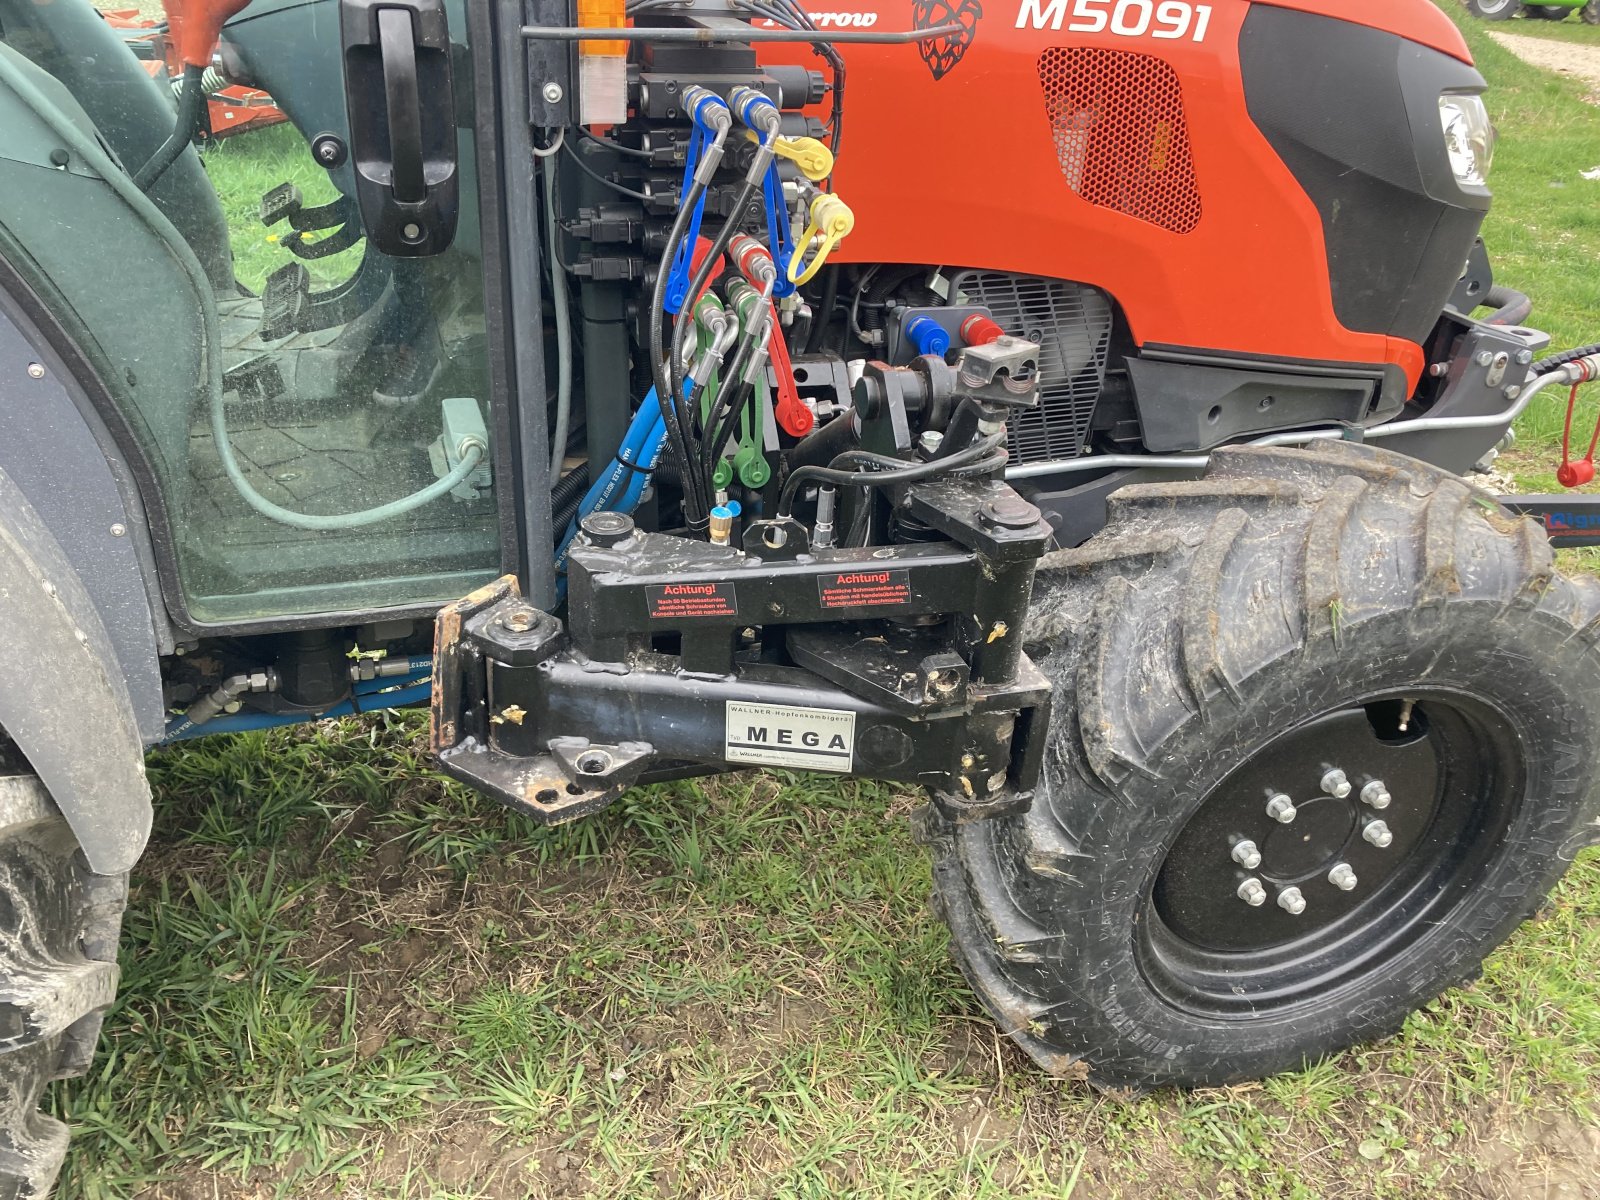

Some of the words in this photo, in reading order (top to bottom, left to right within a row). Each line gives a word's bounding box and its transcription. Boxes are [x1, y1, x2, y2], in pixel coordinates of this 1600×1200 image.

[1014, 0, 1213, 43] M5091
[836, 572, 890, 585] Achtung!
[664, 583, 716, 595] Achtung!
[861, 591, 909, 599] handelsüblichem
[826, 599, 867, 607] Hochdruckfett
[730, 734, 741, 742] Typ
[747, 726, 847, 750] MEGA
